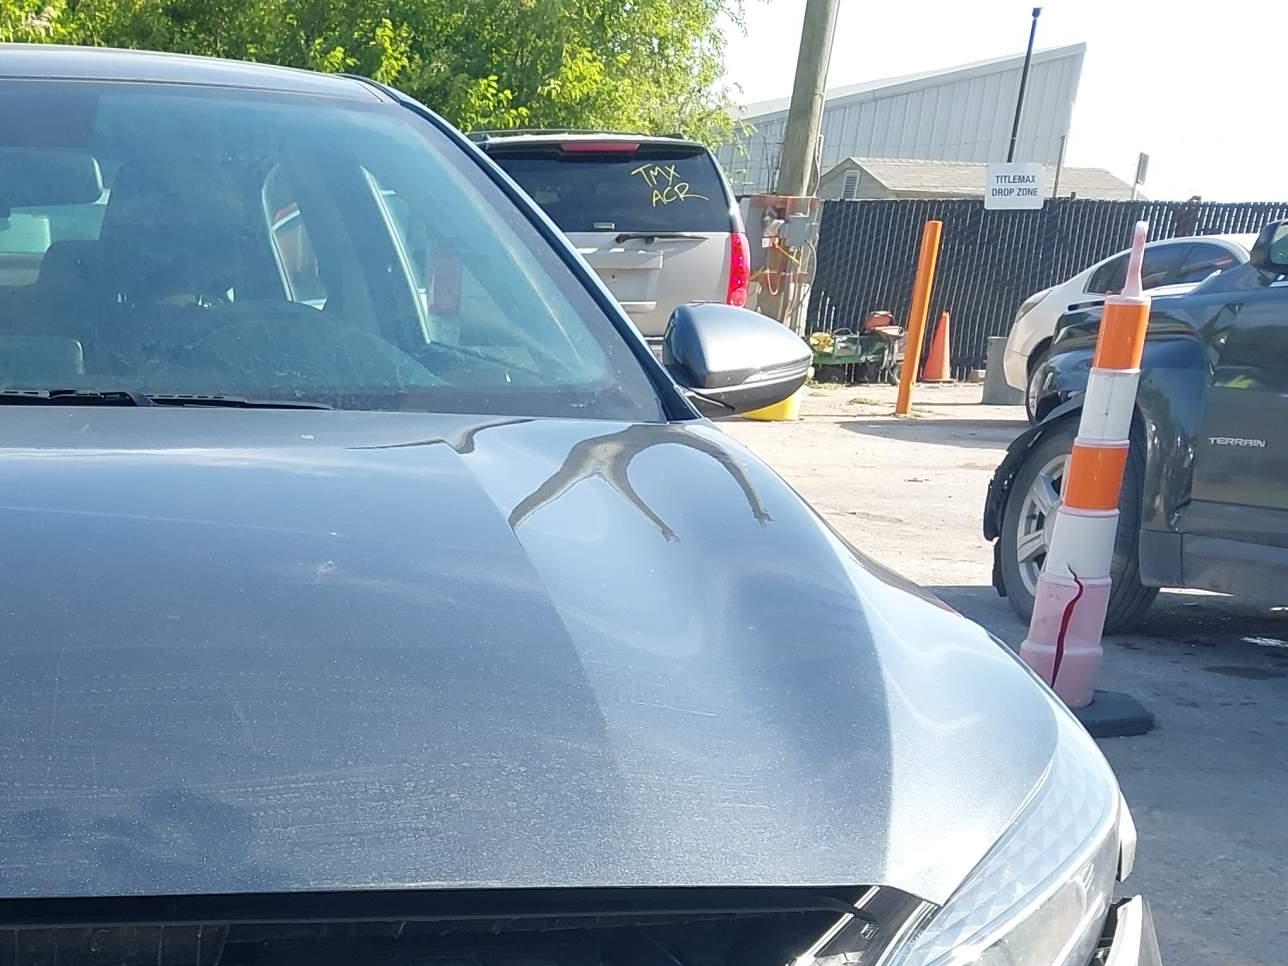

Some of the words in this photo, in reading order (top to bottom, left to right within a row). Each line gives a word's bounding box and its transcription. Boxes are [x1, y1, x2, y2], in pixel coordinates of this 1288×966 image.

[631, 163, 680, 187] TMX
[995, 175, 1037, 184] TITLEMAX
[651, 182, 709, 208] ACR
[991, 188, 1015, 197] DROP
[1016, 187, 1039, 197] ZONE
[1208, 436, 1266, 448] TERRAIN
